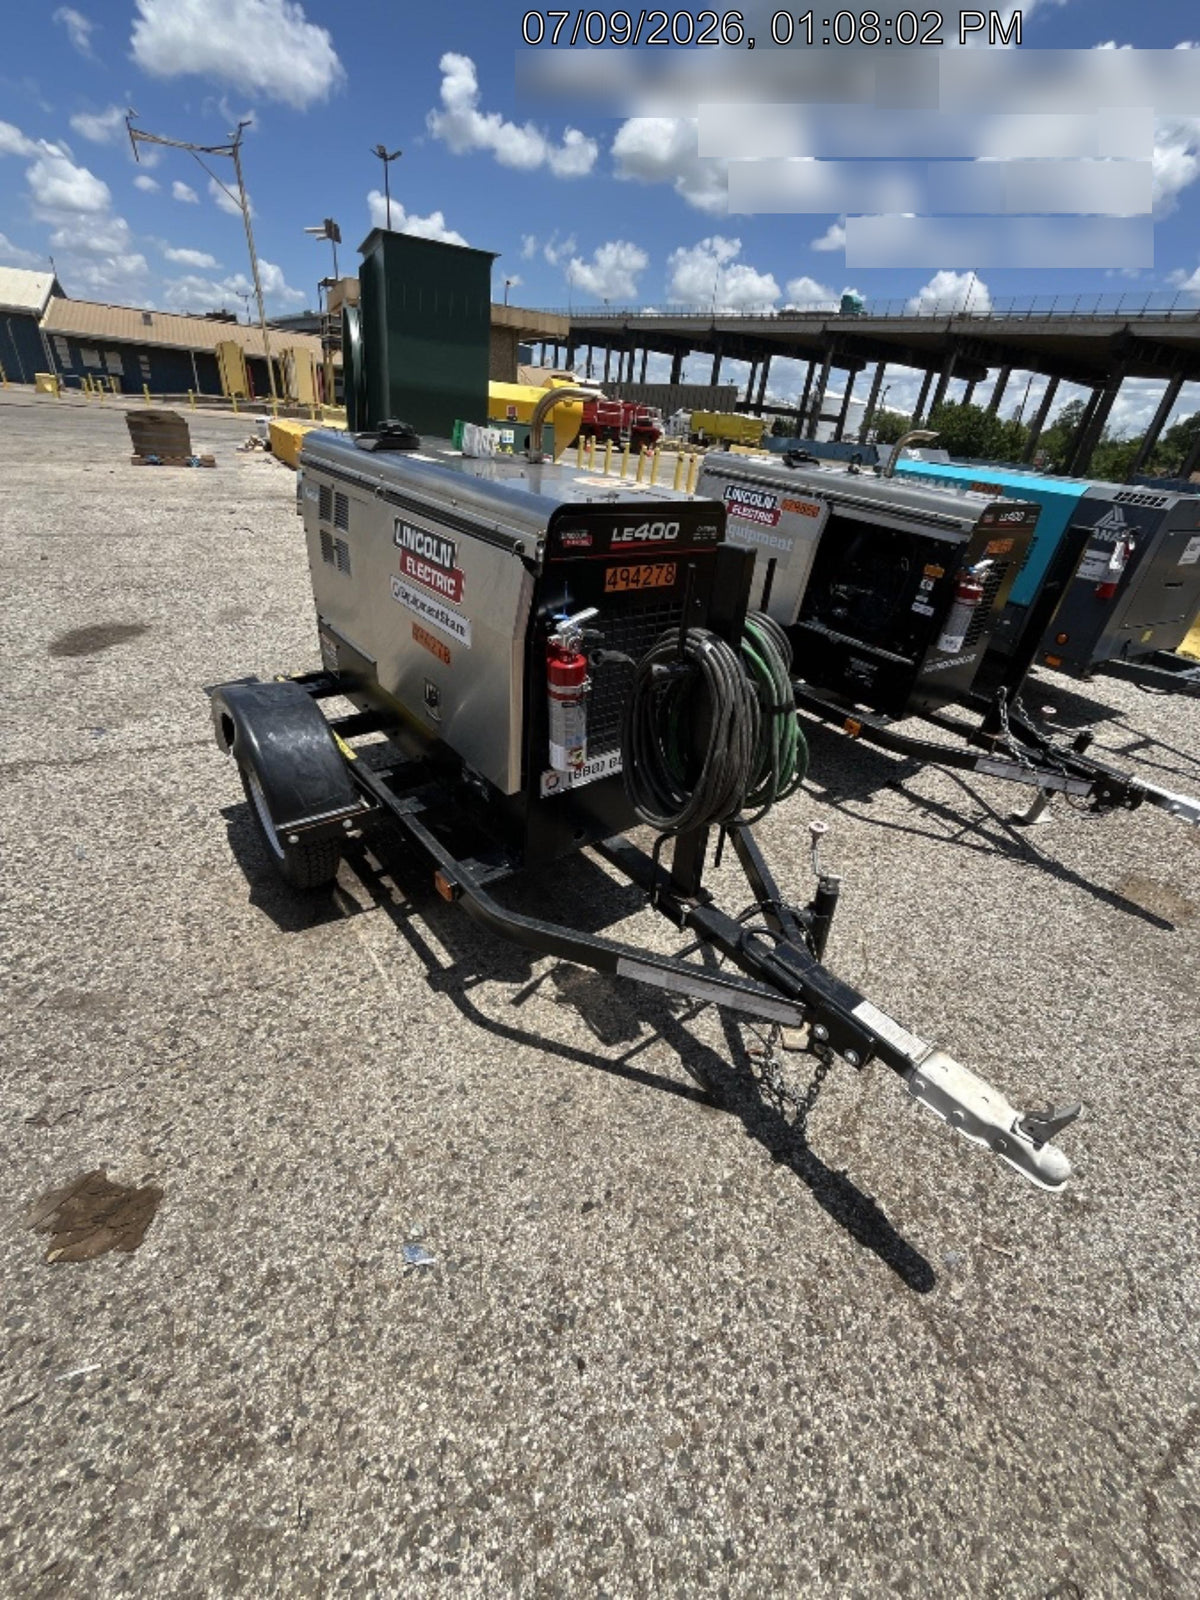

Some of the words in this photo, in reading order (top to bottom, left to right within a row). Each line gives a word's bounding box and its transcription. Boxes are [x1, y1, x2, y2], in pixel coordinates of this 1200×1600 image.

[725, 487, 775, 509] LINCOLN
[731, 504, 774, 523] ELECTRIC
[395, 521, 453, 568] LINCOLN
[609, 522, 680, 542] LE400
[728, 523, 794, 552] quipment
[406, 556, 456, 599] ELECTRIC
[607, 563, 675, 589] 494278
